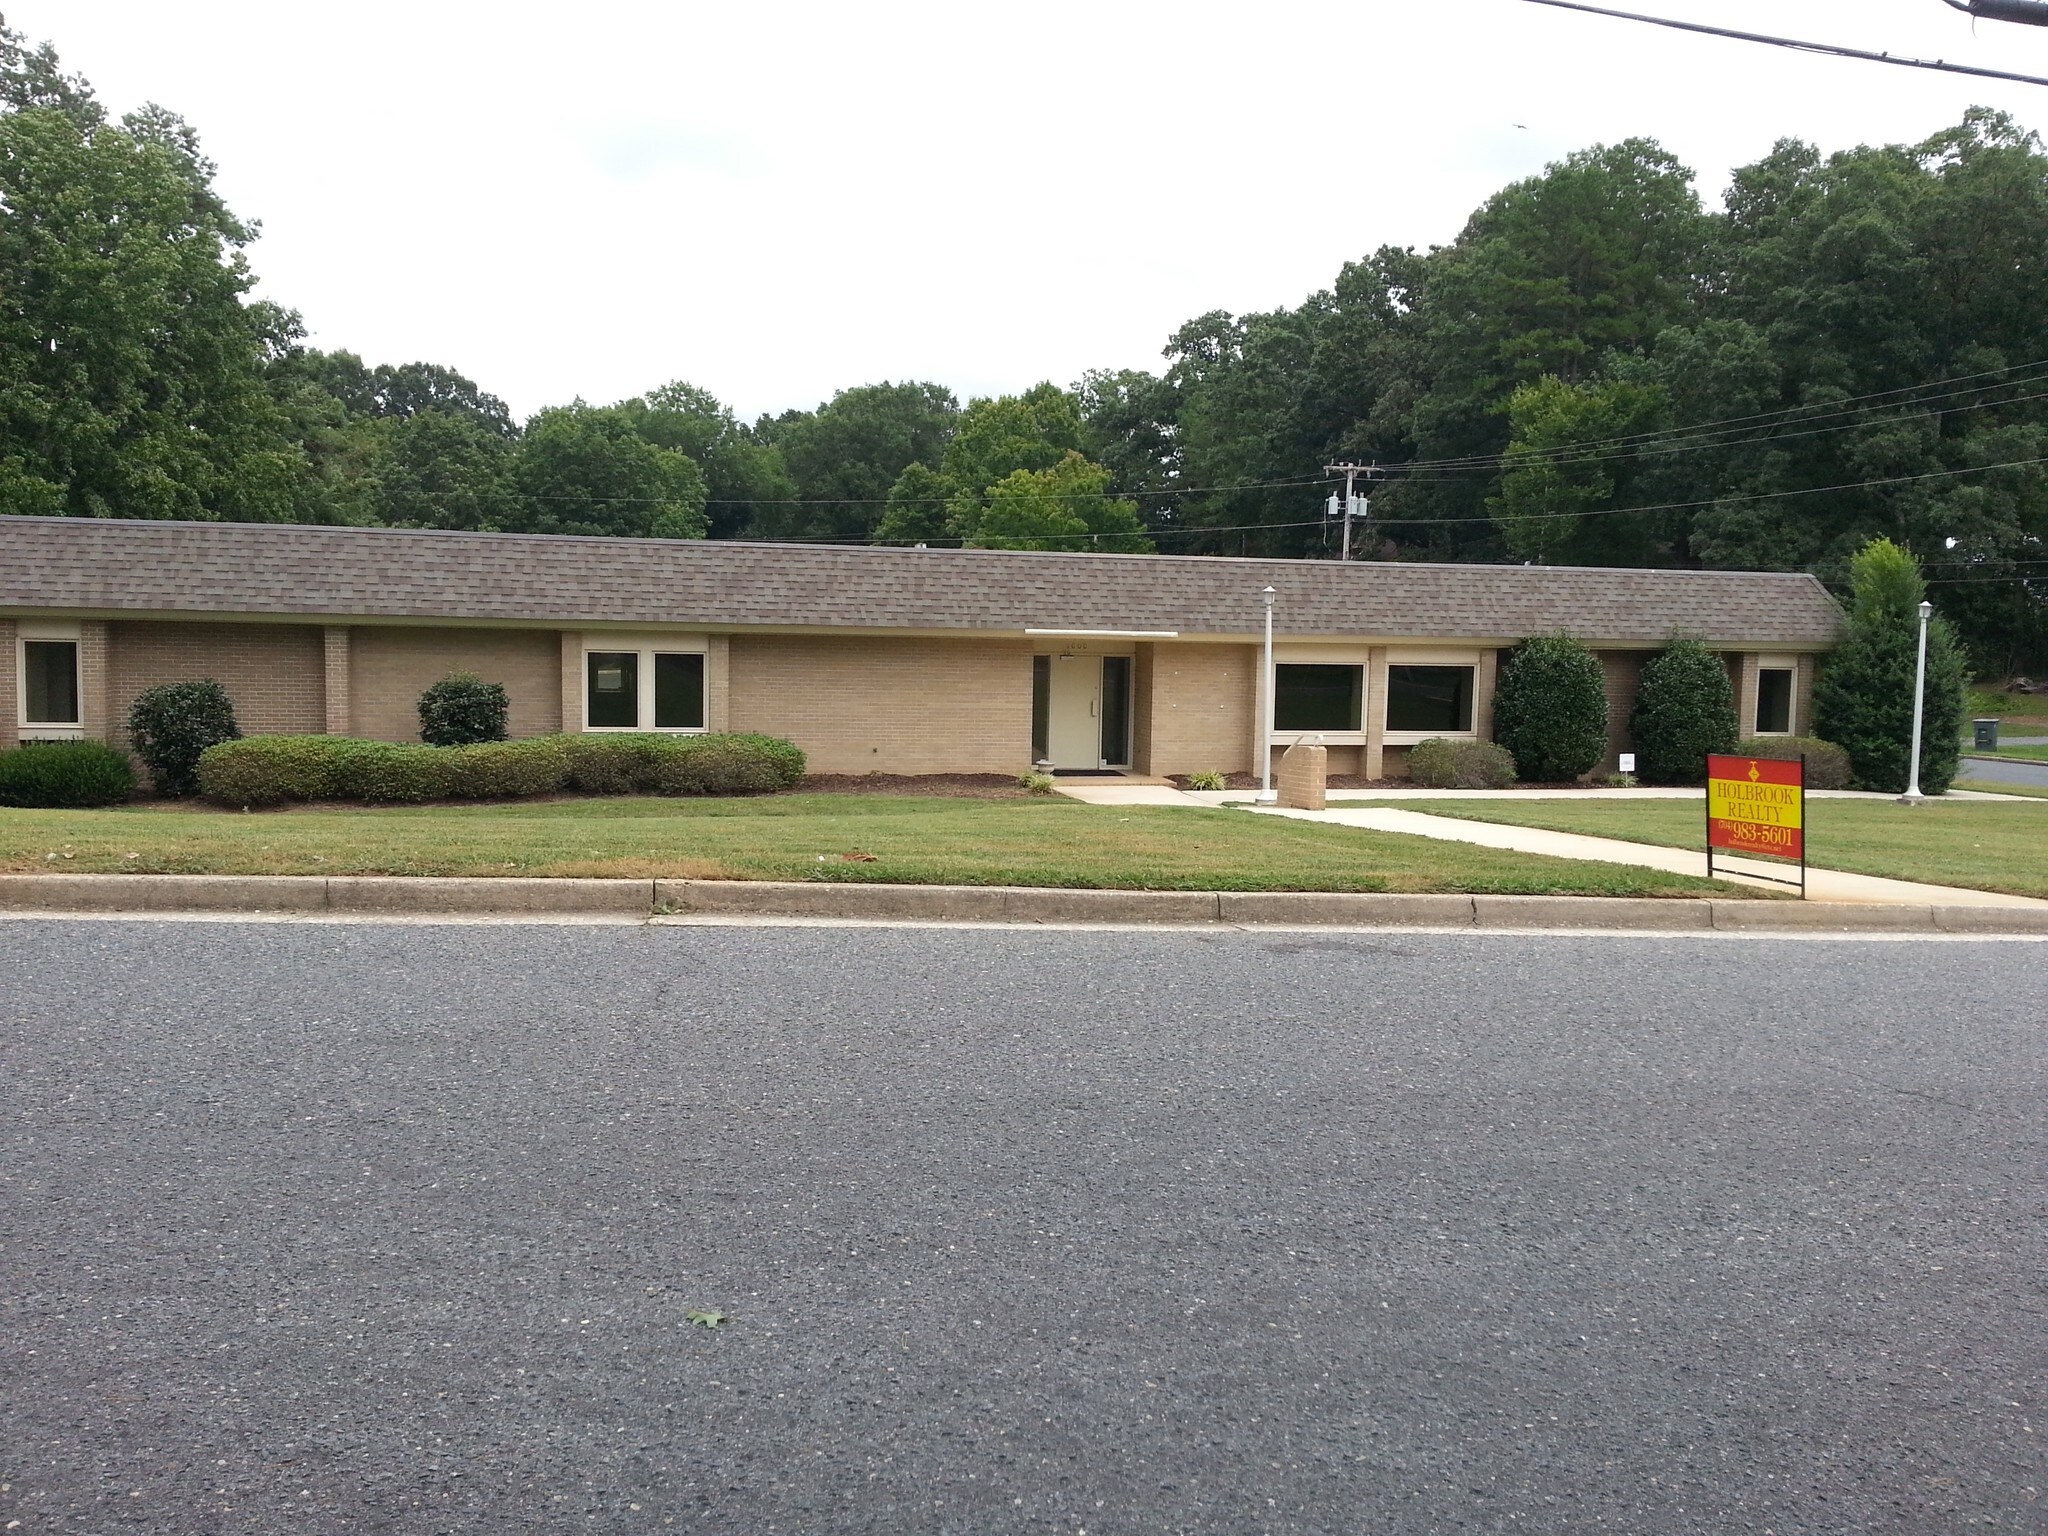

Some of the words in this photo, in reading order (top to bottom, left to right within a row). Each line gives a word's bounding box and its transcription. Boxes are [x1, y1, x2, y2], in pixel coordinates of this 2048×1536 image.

[1717, 782, 1794, 805] HOLBROOK
[1728, 801, 1783, 822] REALTY
[1733, 821, 1793, 846] 983-5601
